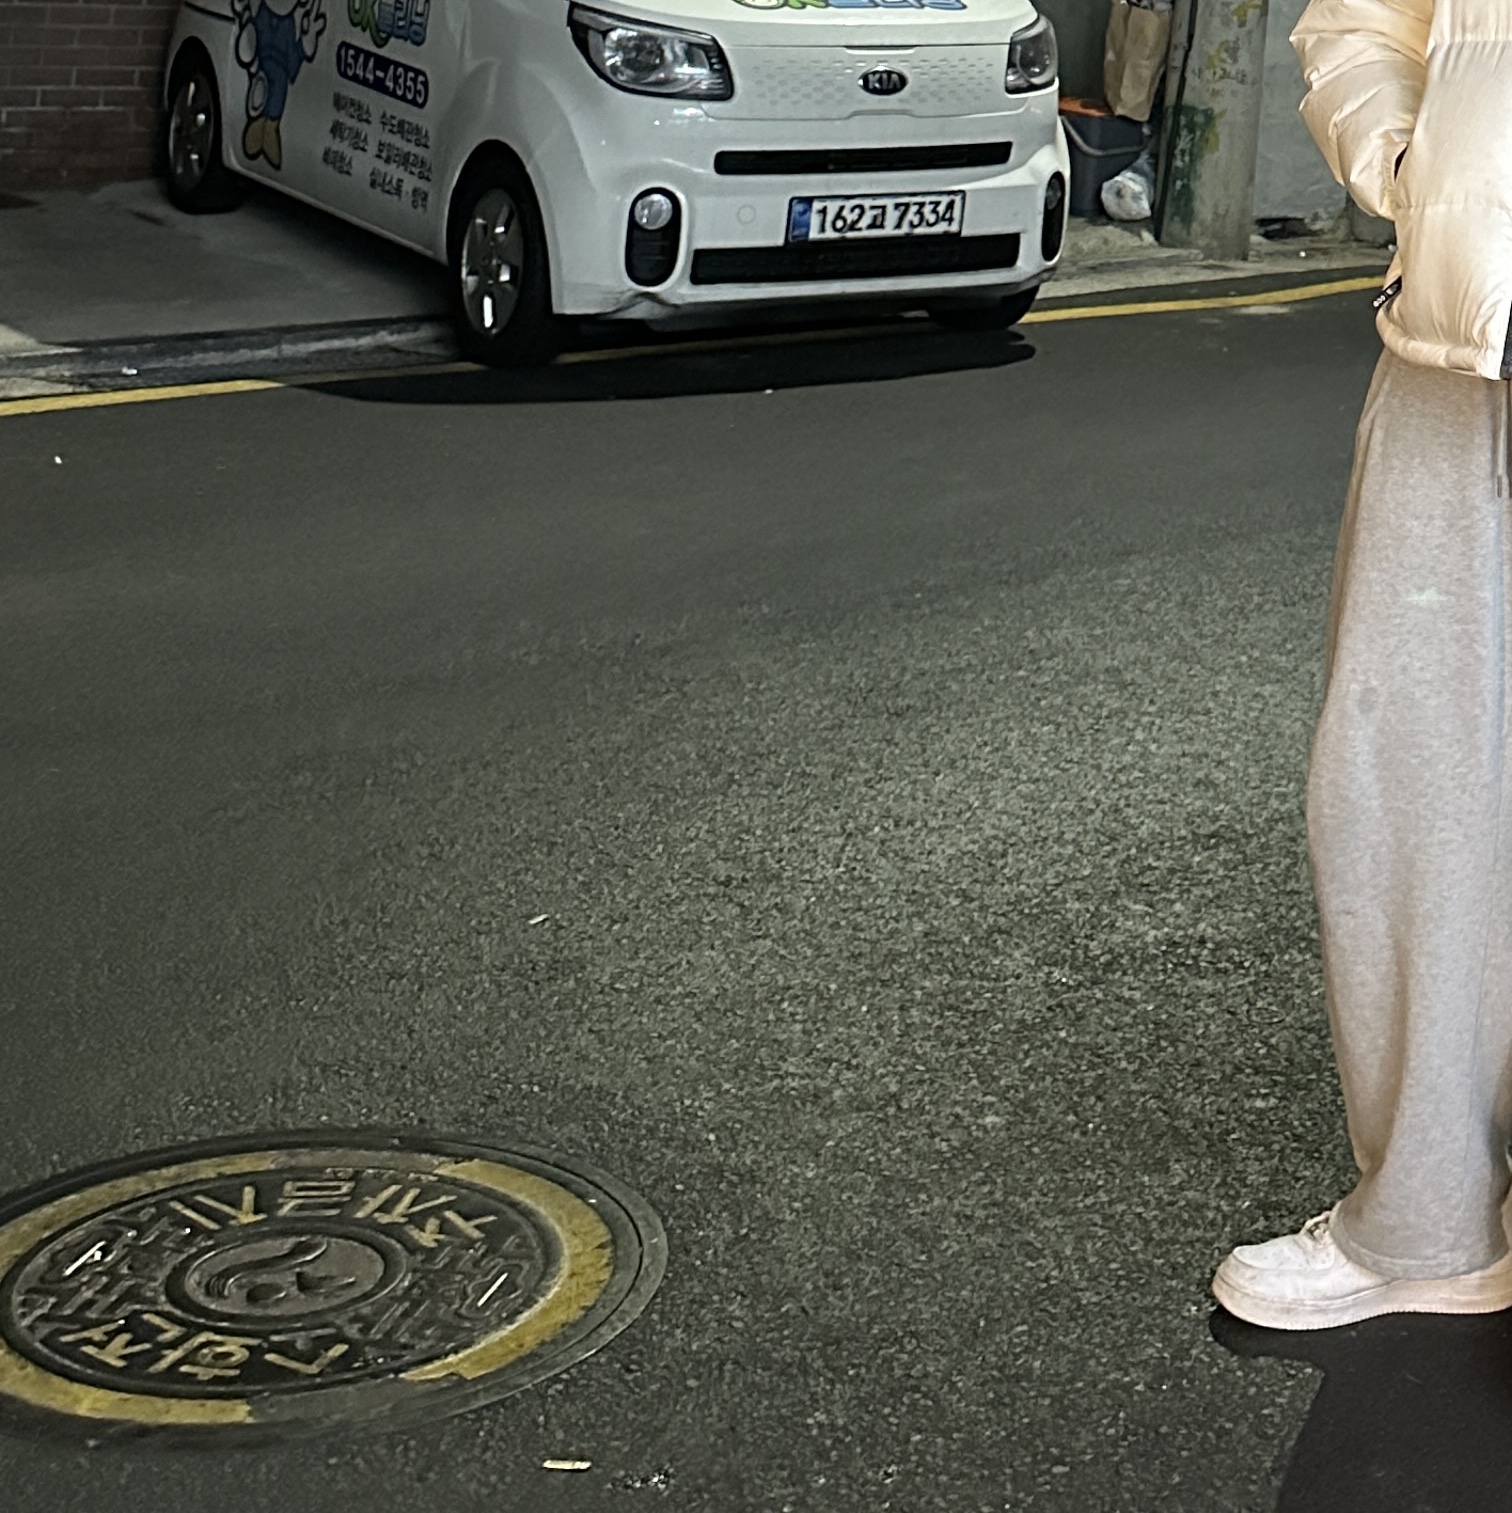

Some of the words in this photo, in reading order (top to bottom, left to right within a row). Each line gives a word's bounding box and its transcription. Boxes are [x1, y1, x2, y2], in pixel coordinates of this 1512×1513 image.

[340, 46, 426, 105] 1544-4355
[867, 72, 901, 91] KIA
[893, 198, 957, 231] 7334
[57, 1311, 351, 1381] 소화전
